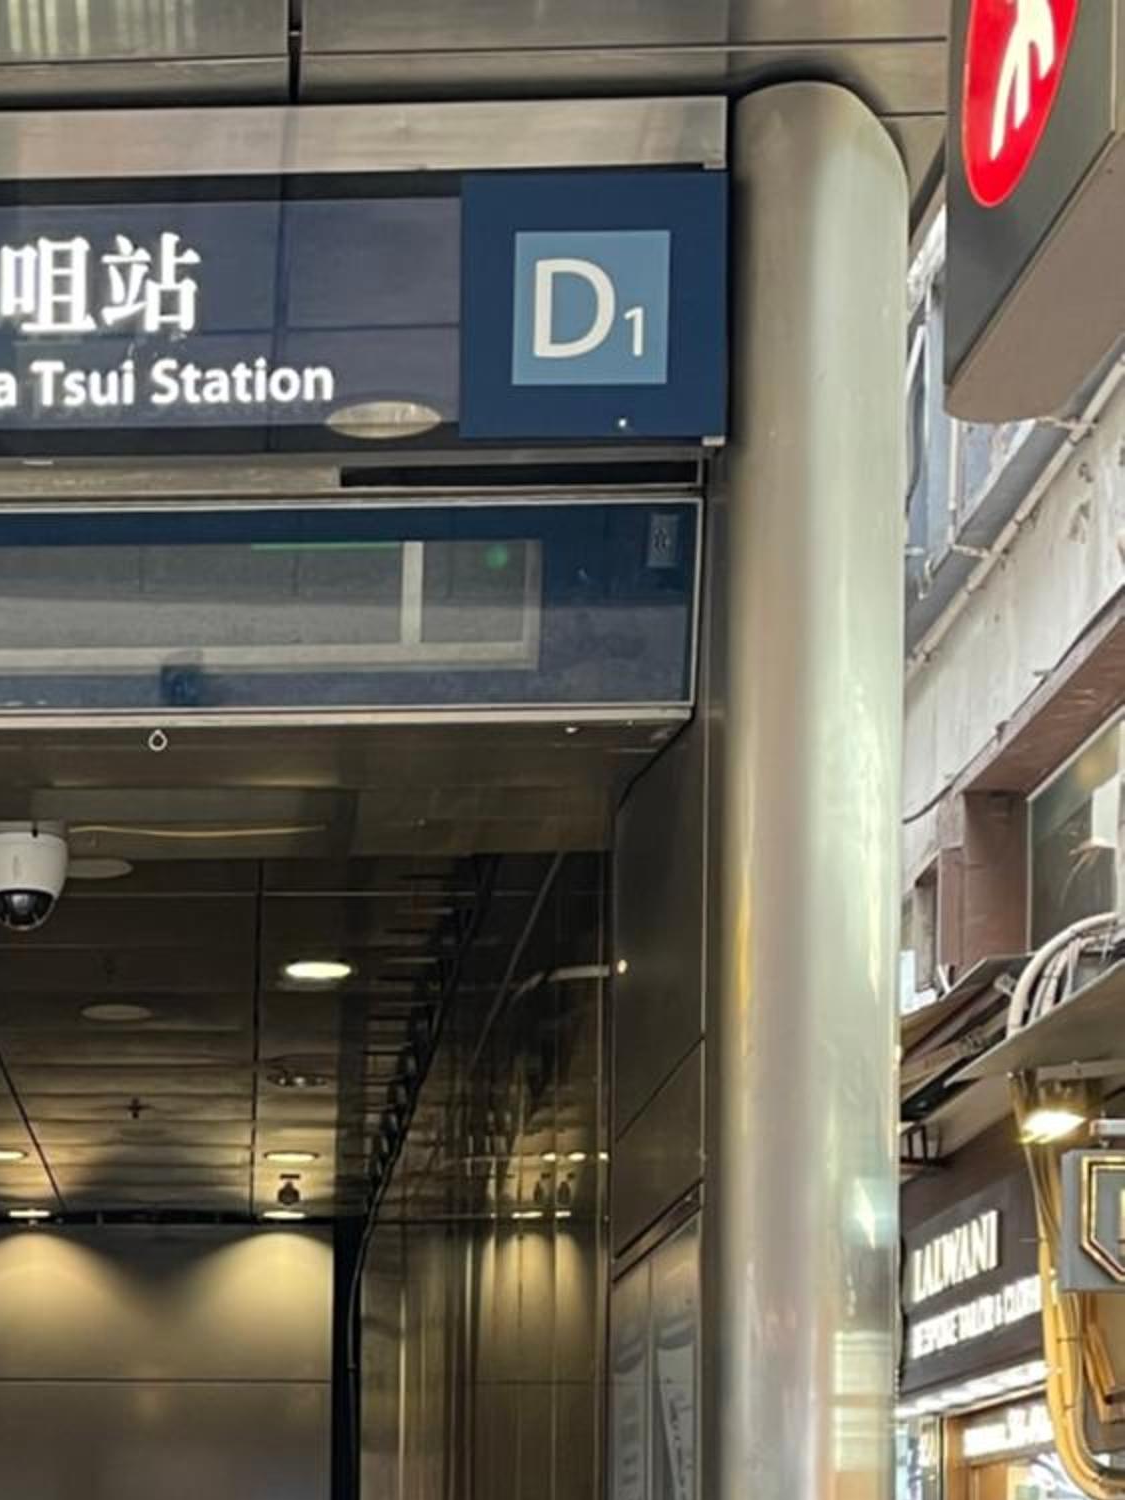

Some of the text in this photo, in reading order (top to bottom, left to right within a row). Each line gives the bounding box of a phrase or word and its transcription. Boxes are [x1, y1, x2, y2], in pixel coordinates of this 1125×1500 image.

[532, 257, 645, 359] D1
[31, 357, 136, 407] Tsui
[150, 356, 335, 405] Station
